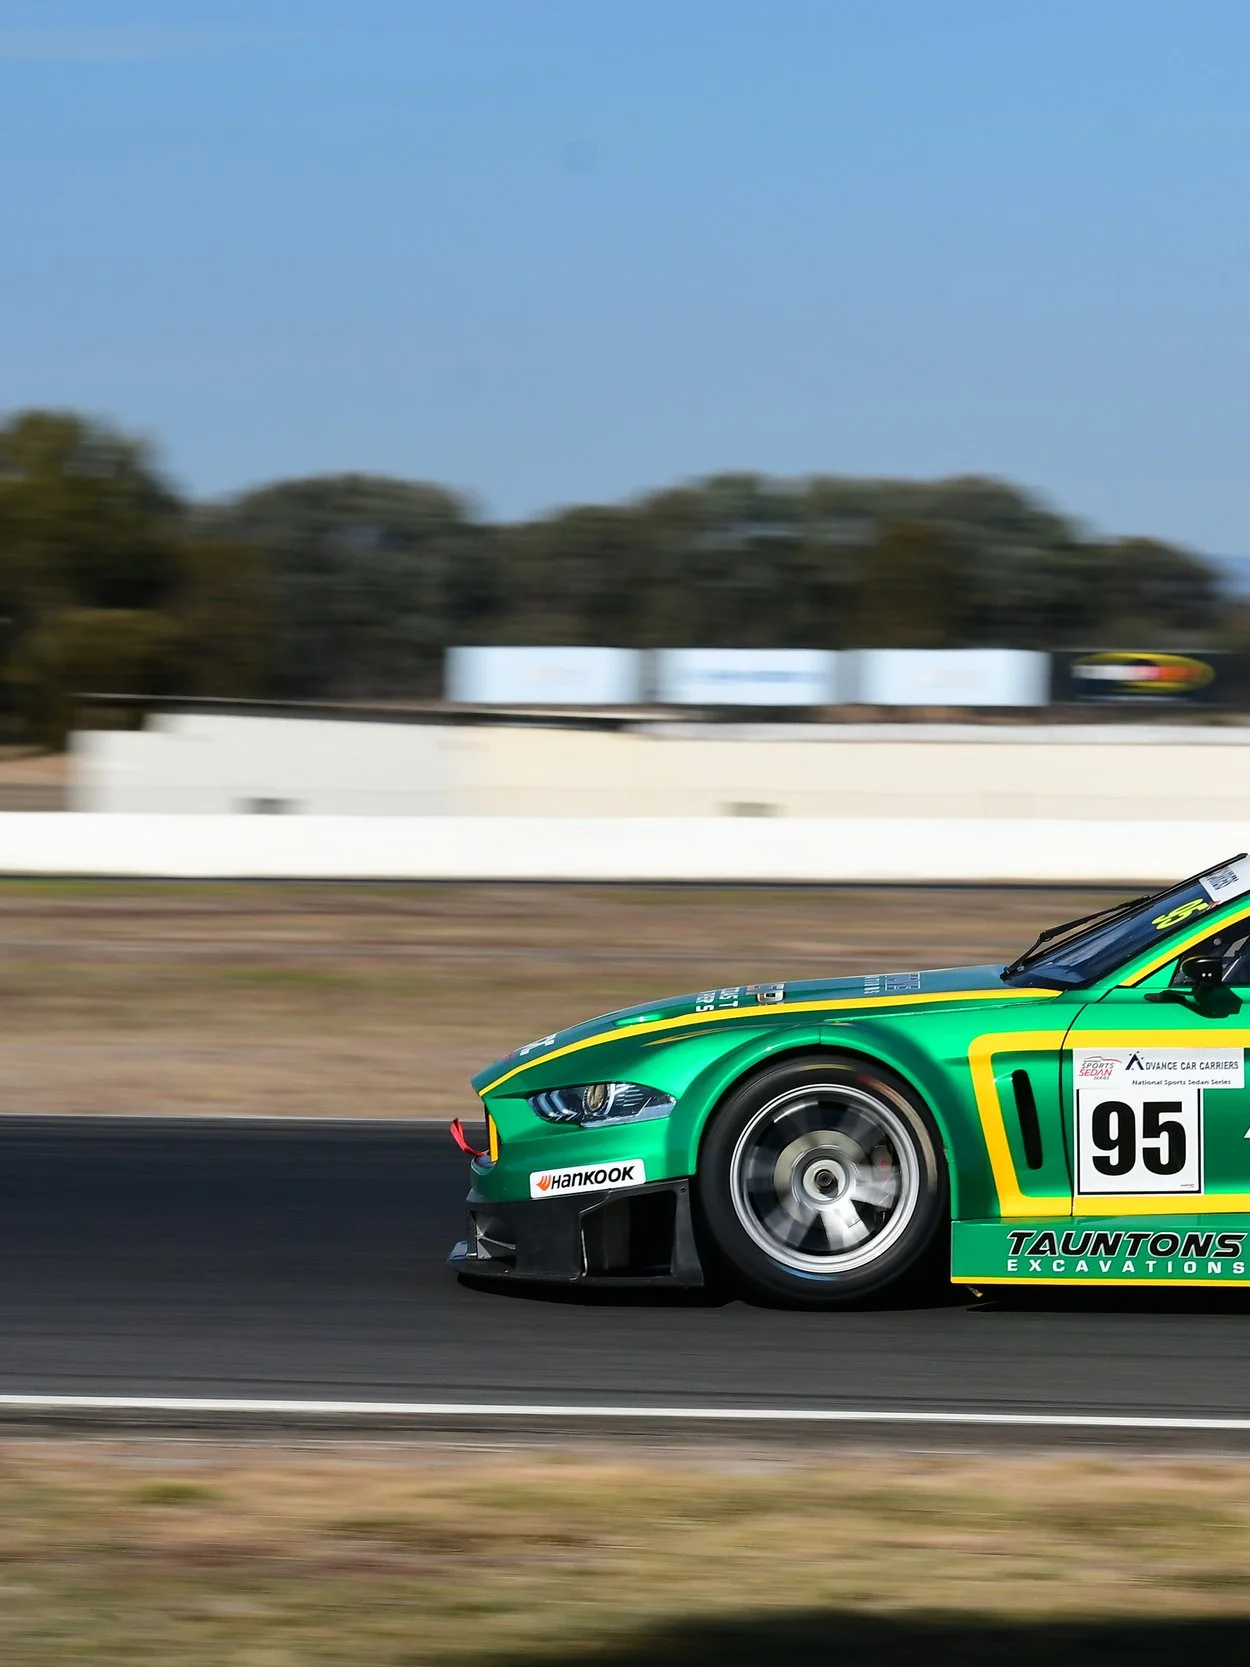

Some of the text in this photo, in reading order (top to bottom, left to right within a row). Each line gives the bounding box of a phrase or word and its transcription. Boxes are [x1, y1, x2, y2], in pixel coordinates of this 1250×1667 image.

[1125, 1052, 1239, 1071] ADVANCE CAR CARRIERS
[1079, 1068, 1113, 1076] SEDAN
[1164, 1079, 1186, 1087] Sports
[1092, 1101, 1186, 1176] 95
[1007, 1229, 1248, 1259] TAUNTONS
[1007, 1259, 1245, 1274] EXCAVATIONS
